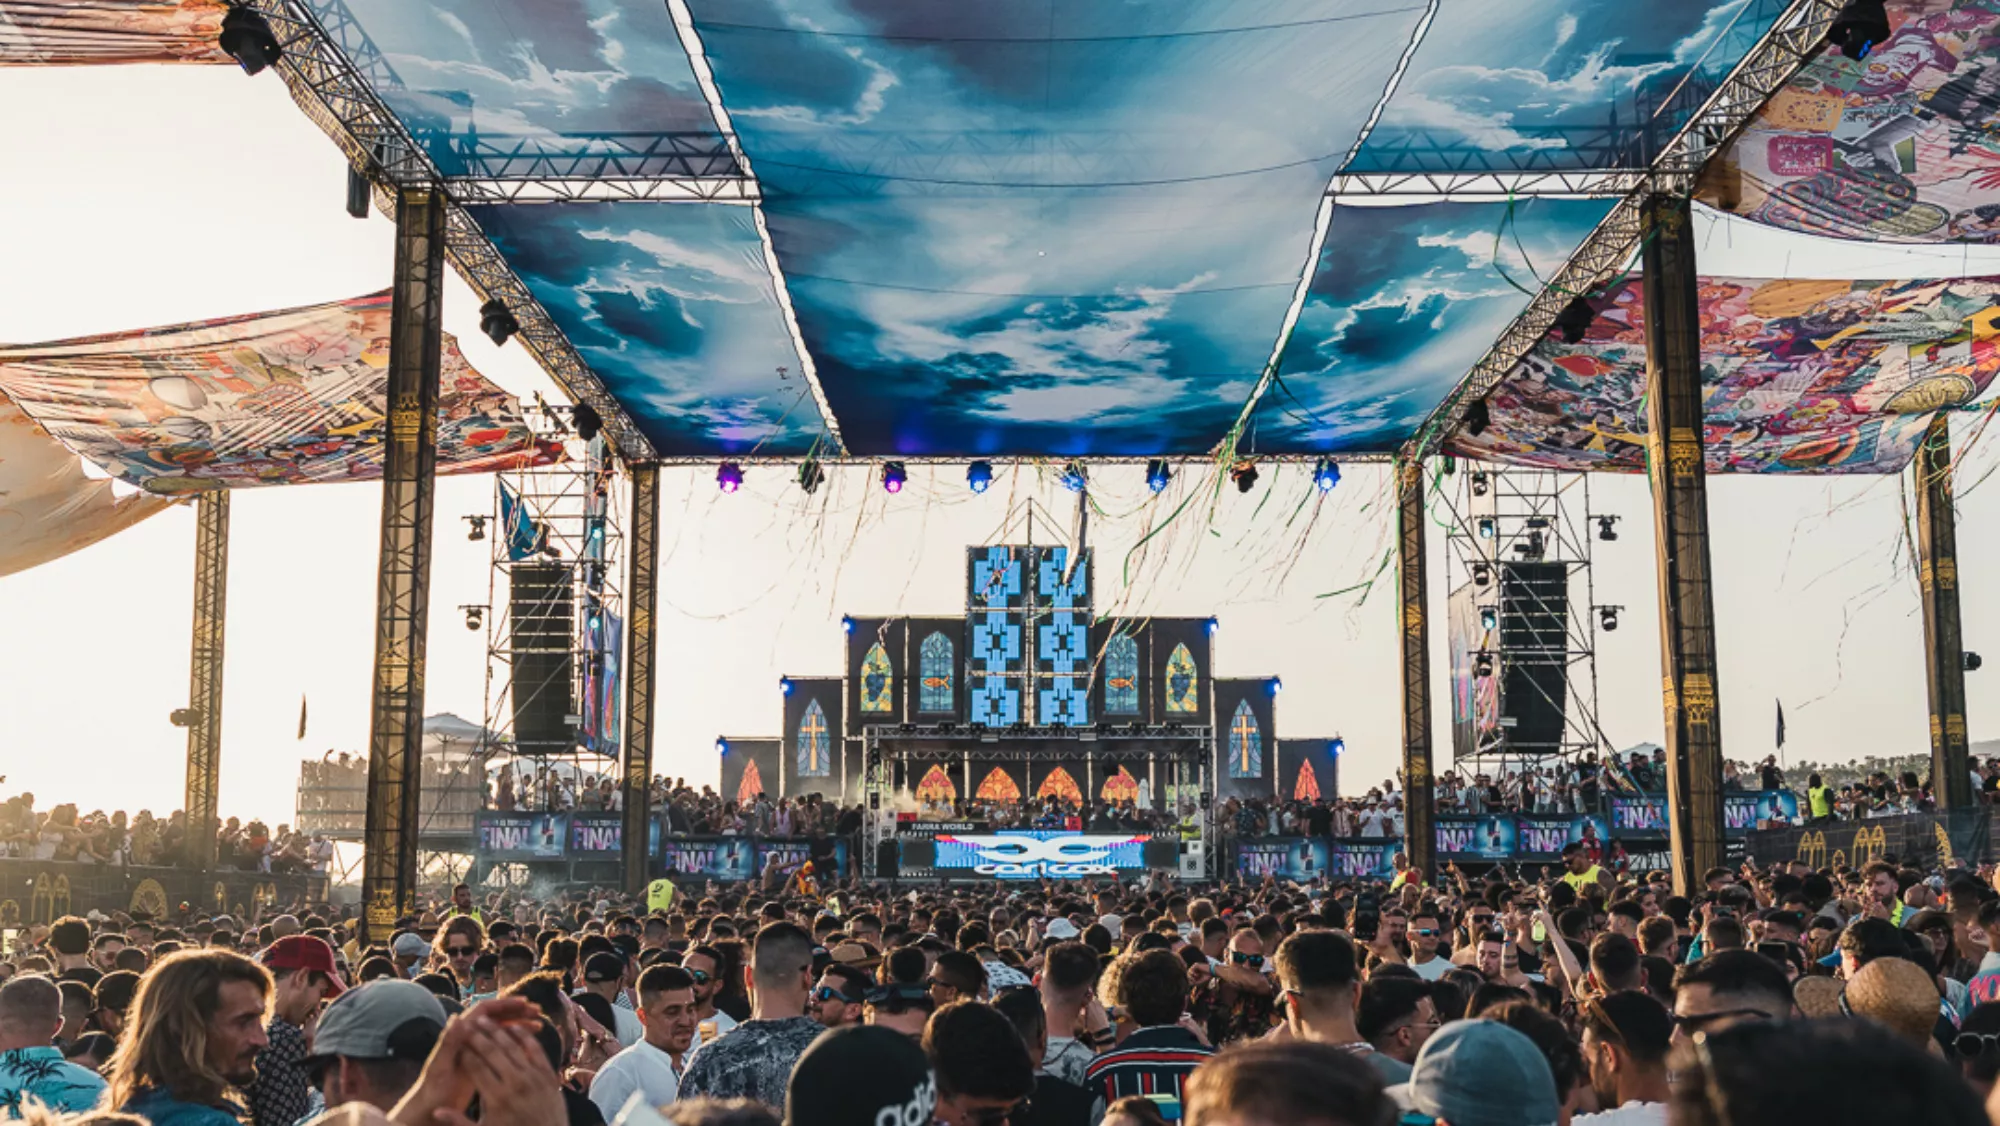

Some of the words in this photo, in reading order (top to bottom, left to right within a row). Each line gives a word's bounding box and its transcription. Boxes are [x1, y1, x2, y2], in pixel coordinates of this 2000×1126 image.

[1613, 807, 1663, 828] FINAL
[1724, 805, 1756, 828] NAL
[480, 827, 530, 850] FINAL
[1435, 829, 1477, 852] INAL
[1519, 829, 1568, 852] FINAL
[665, 850, 716, 873] FINAL
[1239, 853, 1287, 876] FINAL
[1333, 853, 1382, 876] FINAL
